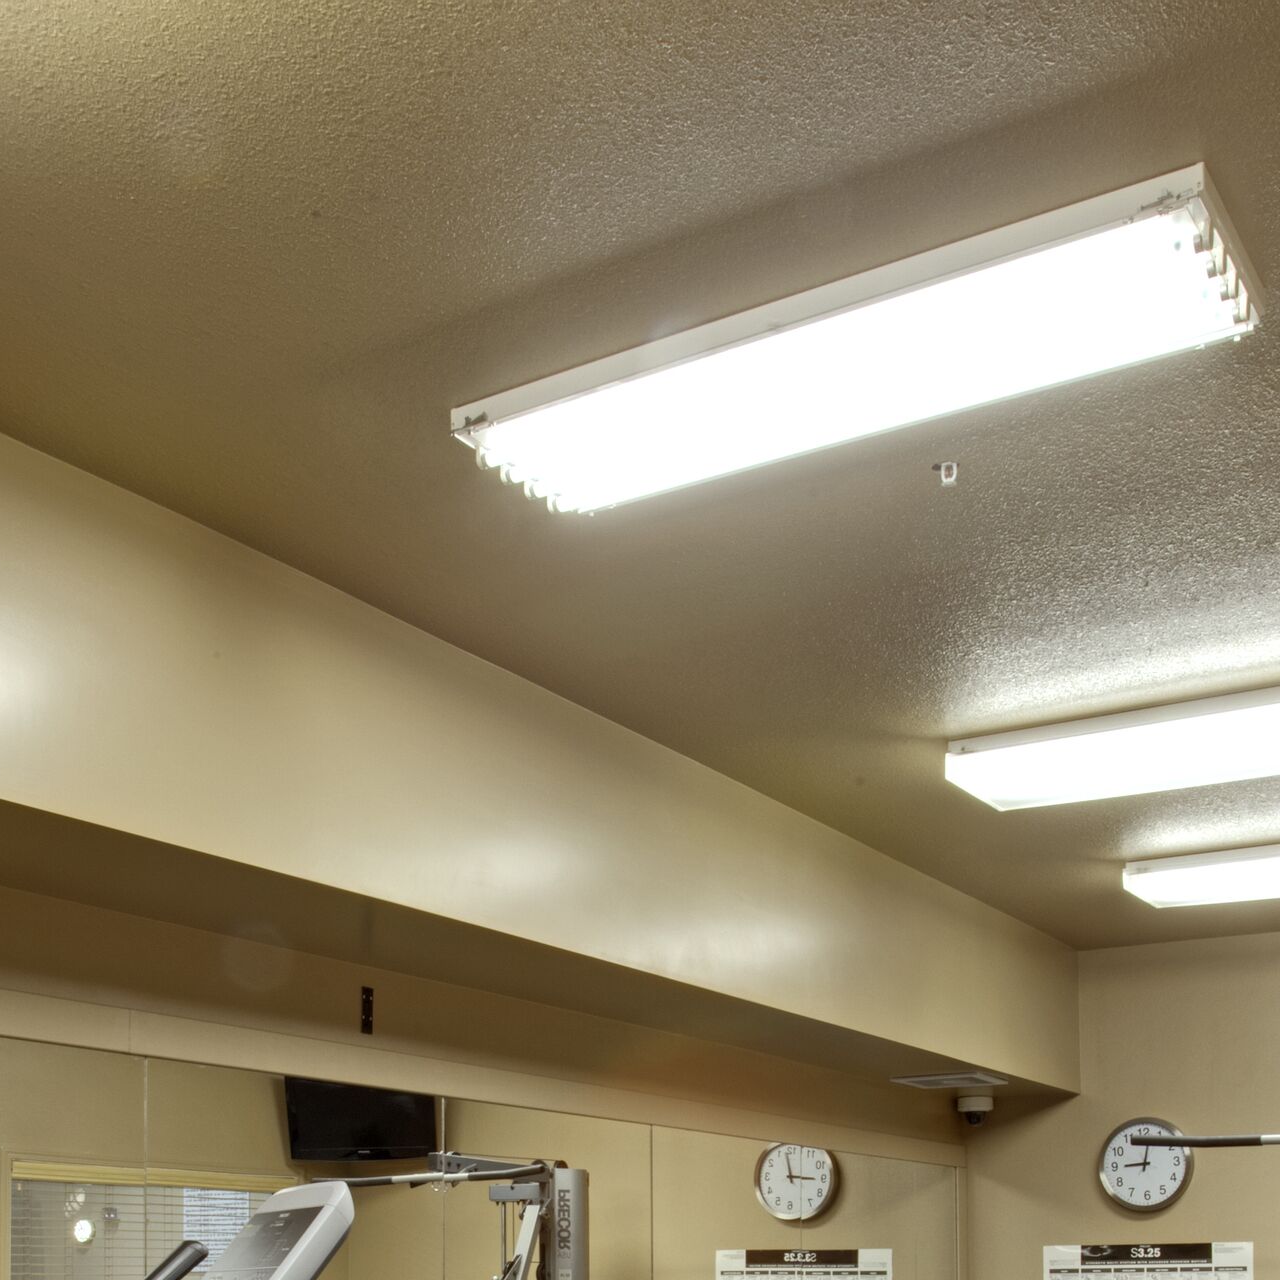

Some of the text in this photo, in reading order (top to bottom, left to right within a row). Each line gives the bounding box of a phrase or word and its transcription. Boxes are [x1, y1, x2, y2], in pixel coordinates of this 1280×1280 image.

[1138, 1127, 1150, 1136] 12
[1112, 1146, 1124, 1157] 10
[1173, 1156, 1180, 1166] 3
[1111, 1161, 1119, 1172] 9
[1116, 1177, 1123, 1187] 8
[1169, 1172, 1177, 1182] 4
[1128, 1187, 1135, 1197] 7
[1143, 1190, 1151, 1200] 6
[1159, 1185, 1167, 1195] 5
[1130, 1247, 1161, 1258] S3.25
